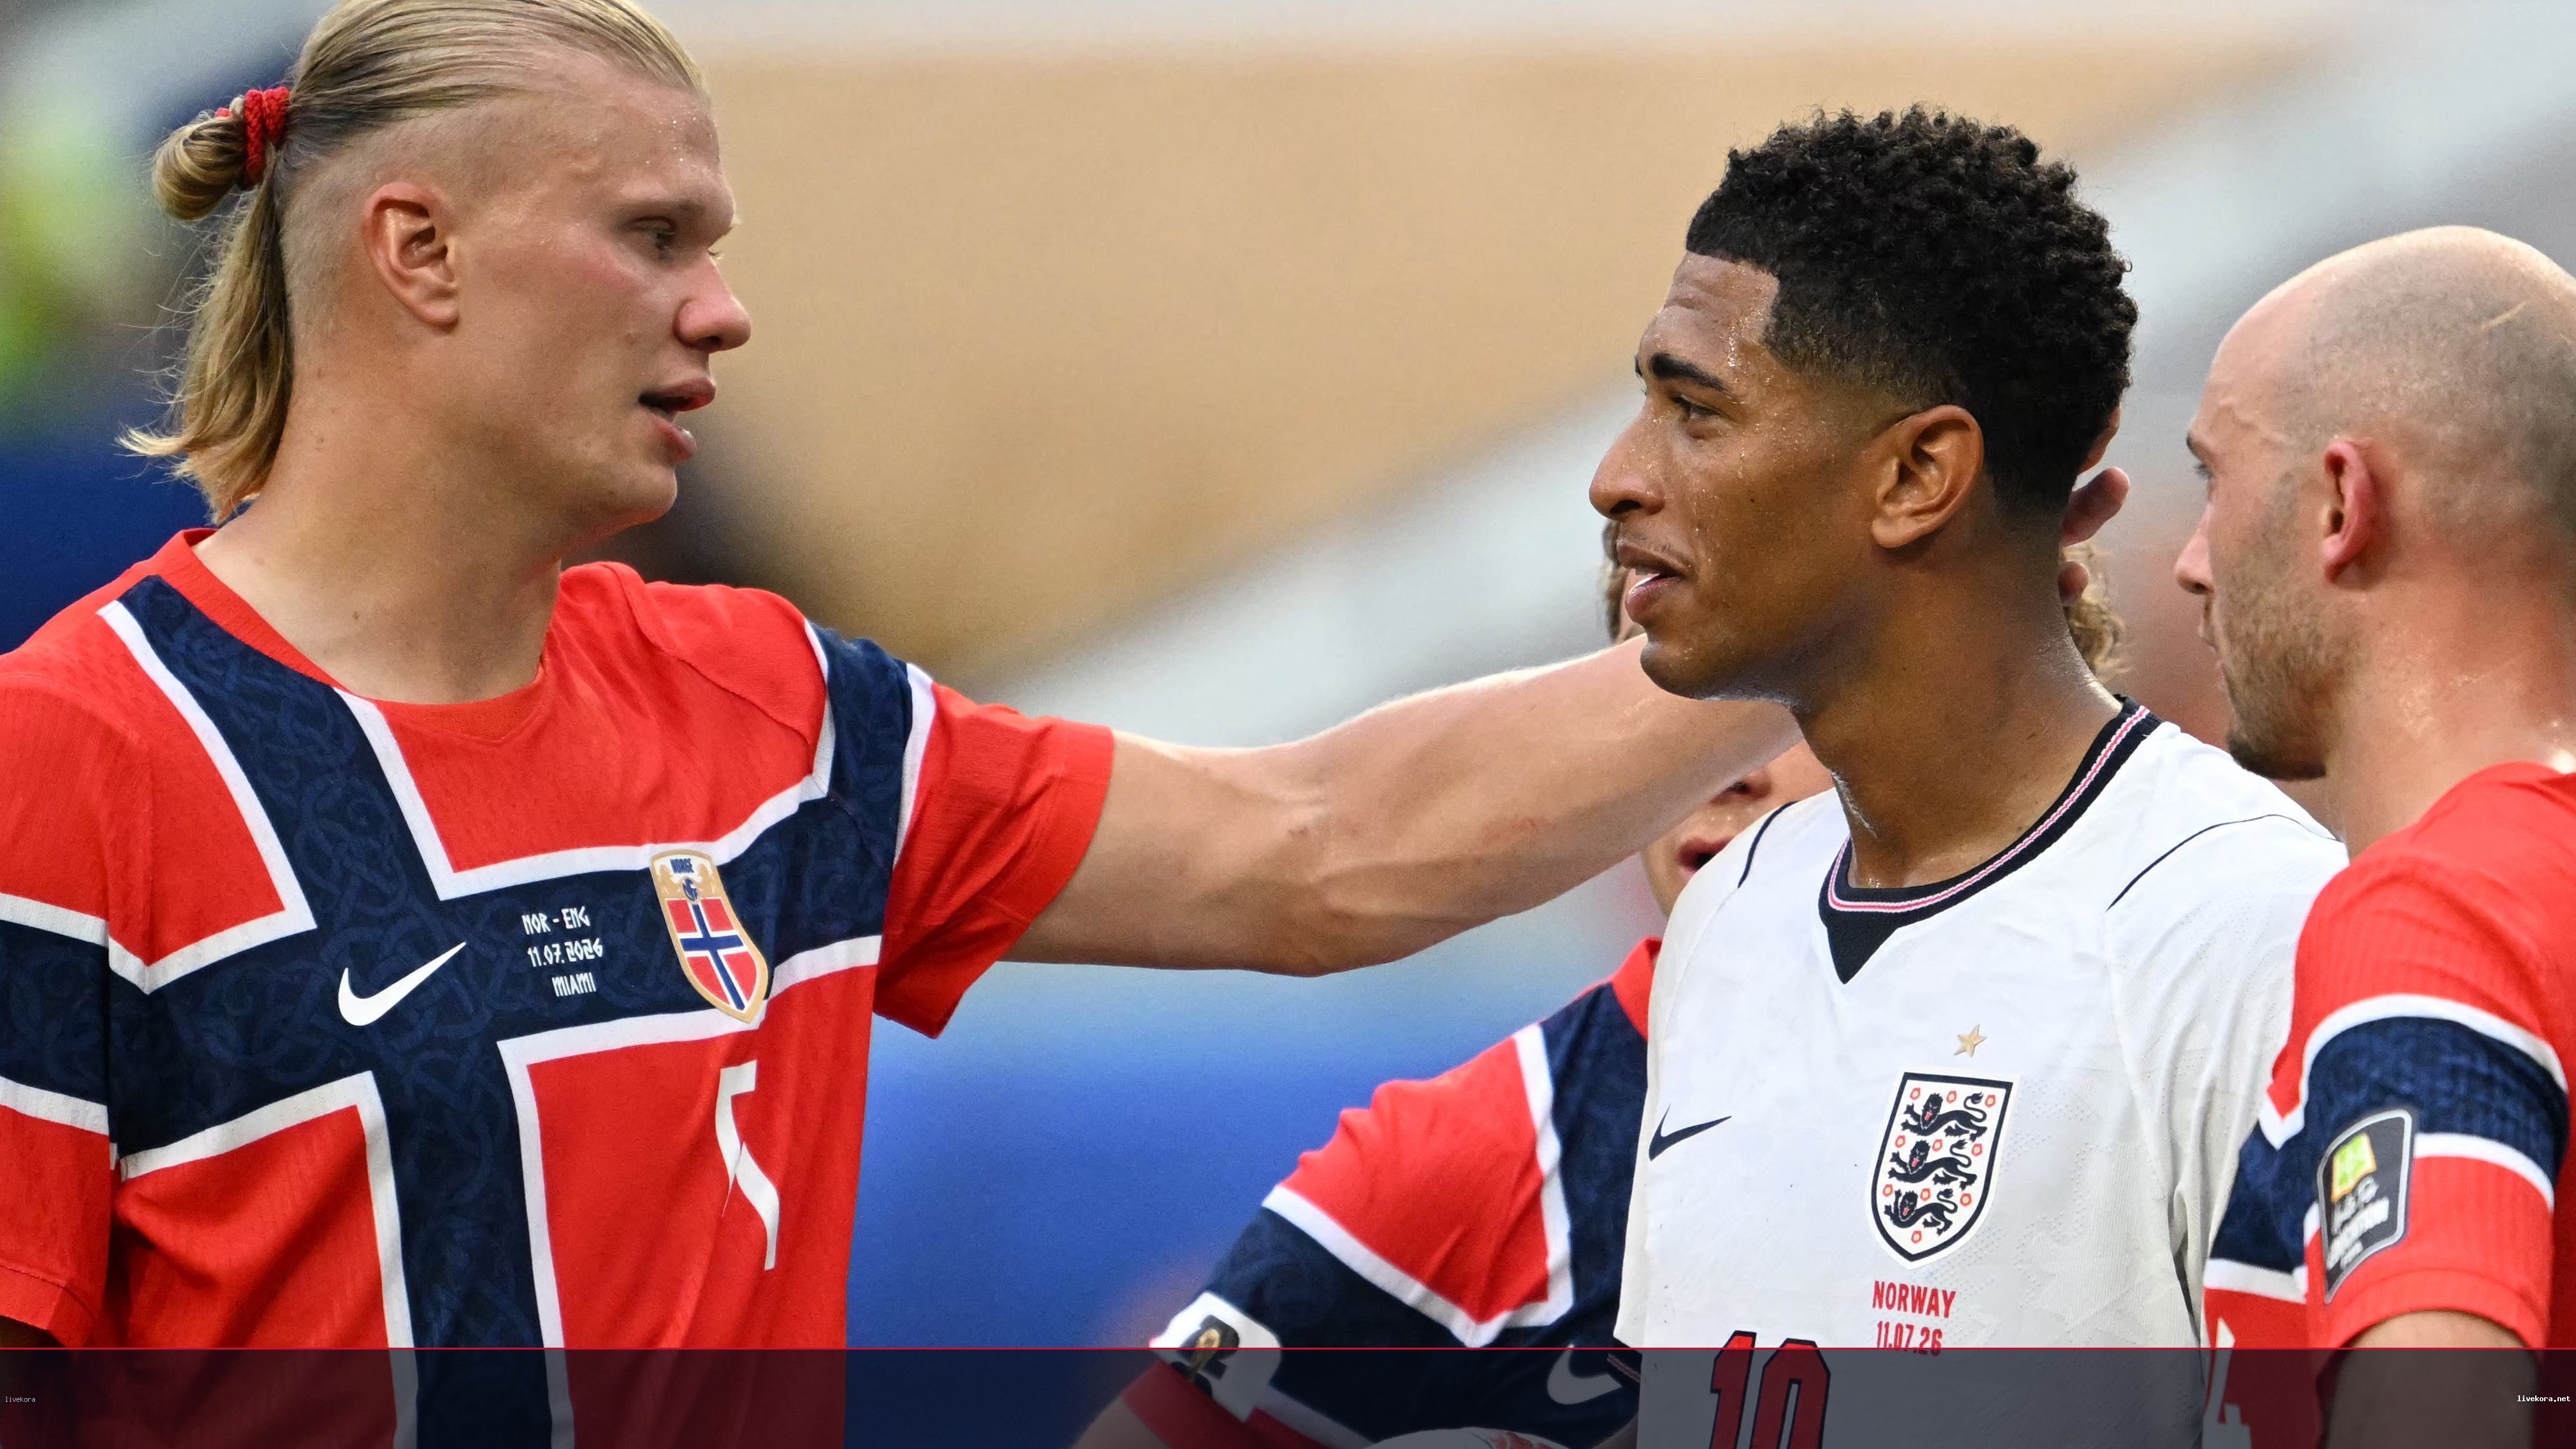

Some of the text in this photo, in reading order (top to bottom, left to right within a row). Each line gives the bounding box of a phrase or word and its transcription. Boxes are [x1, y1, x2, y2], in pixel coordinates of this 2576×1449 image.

[521, 912, 551, 935] NOR
[561, 906, 591, 929] ENG
[527, 938, 603, 967] 11.07.2026
[551, 972, 596, 997] MIAMI
[1872, 1280, 1956, 1318] NORWAY
[1877, 1320, 1943, 1357] 11.07.26
[1708, 1330, 1831, 1449] 10
